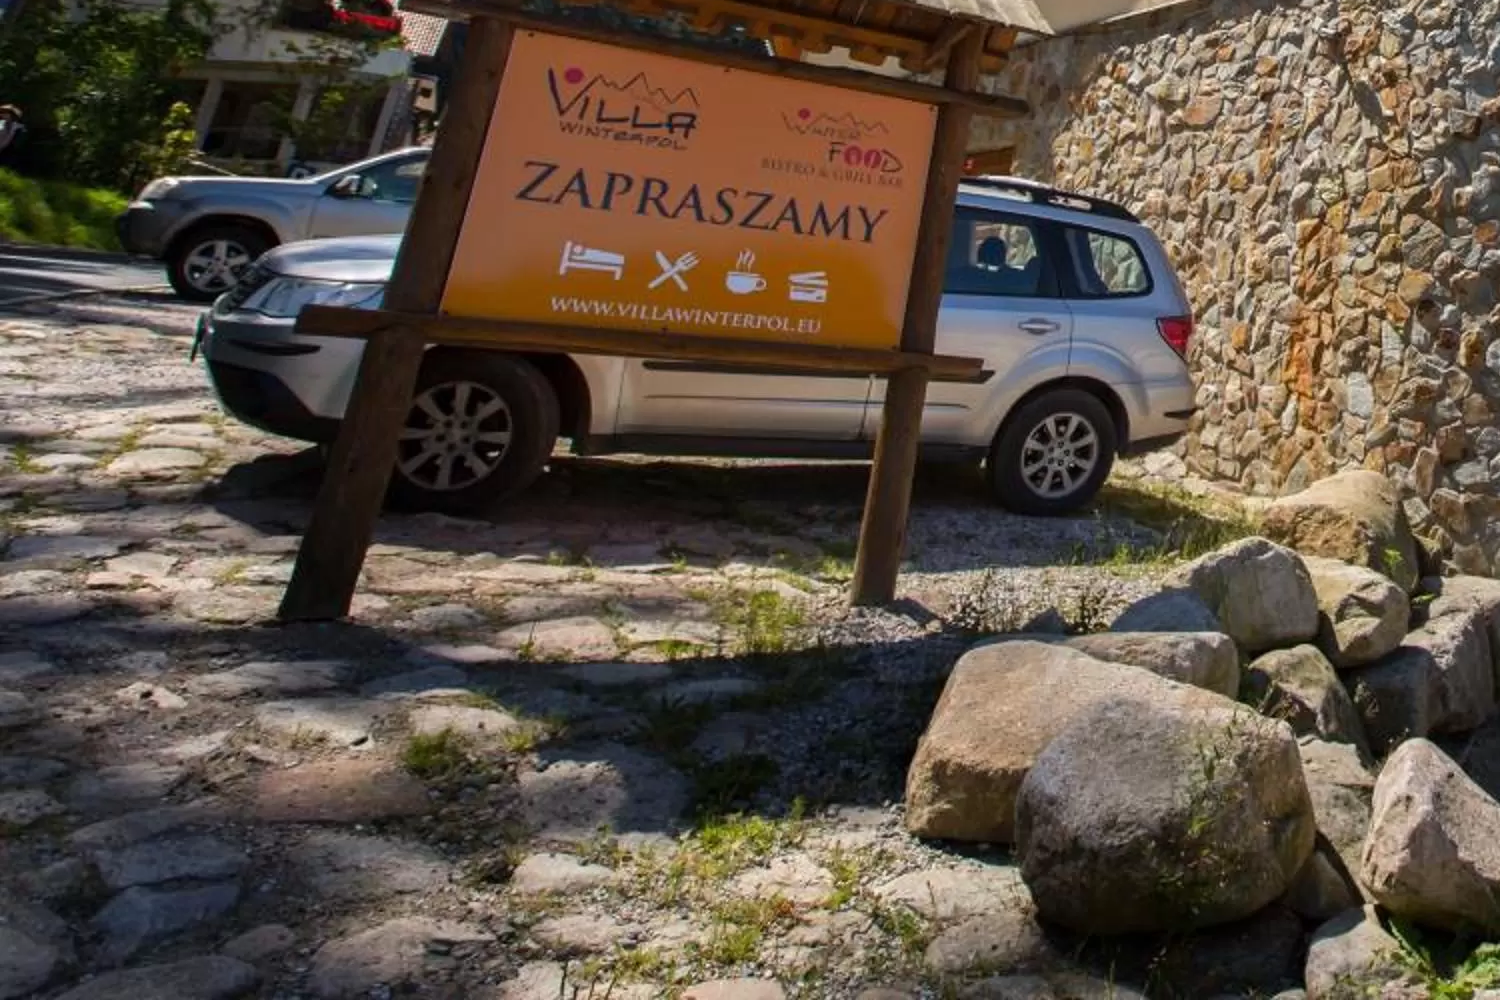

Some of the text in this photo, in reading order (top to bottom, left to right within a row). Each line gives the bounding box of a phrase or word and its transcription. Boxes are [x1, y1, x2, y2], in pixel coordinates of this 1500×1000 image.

[547, 67, 698, 139] VILLA
[559, 120, 688, 150] WINTERPOL
[515, 160, 891, 245] ZAPRASZAMY
